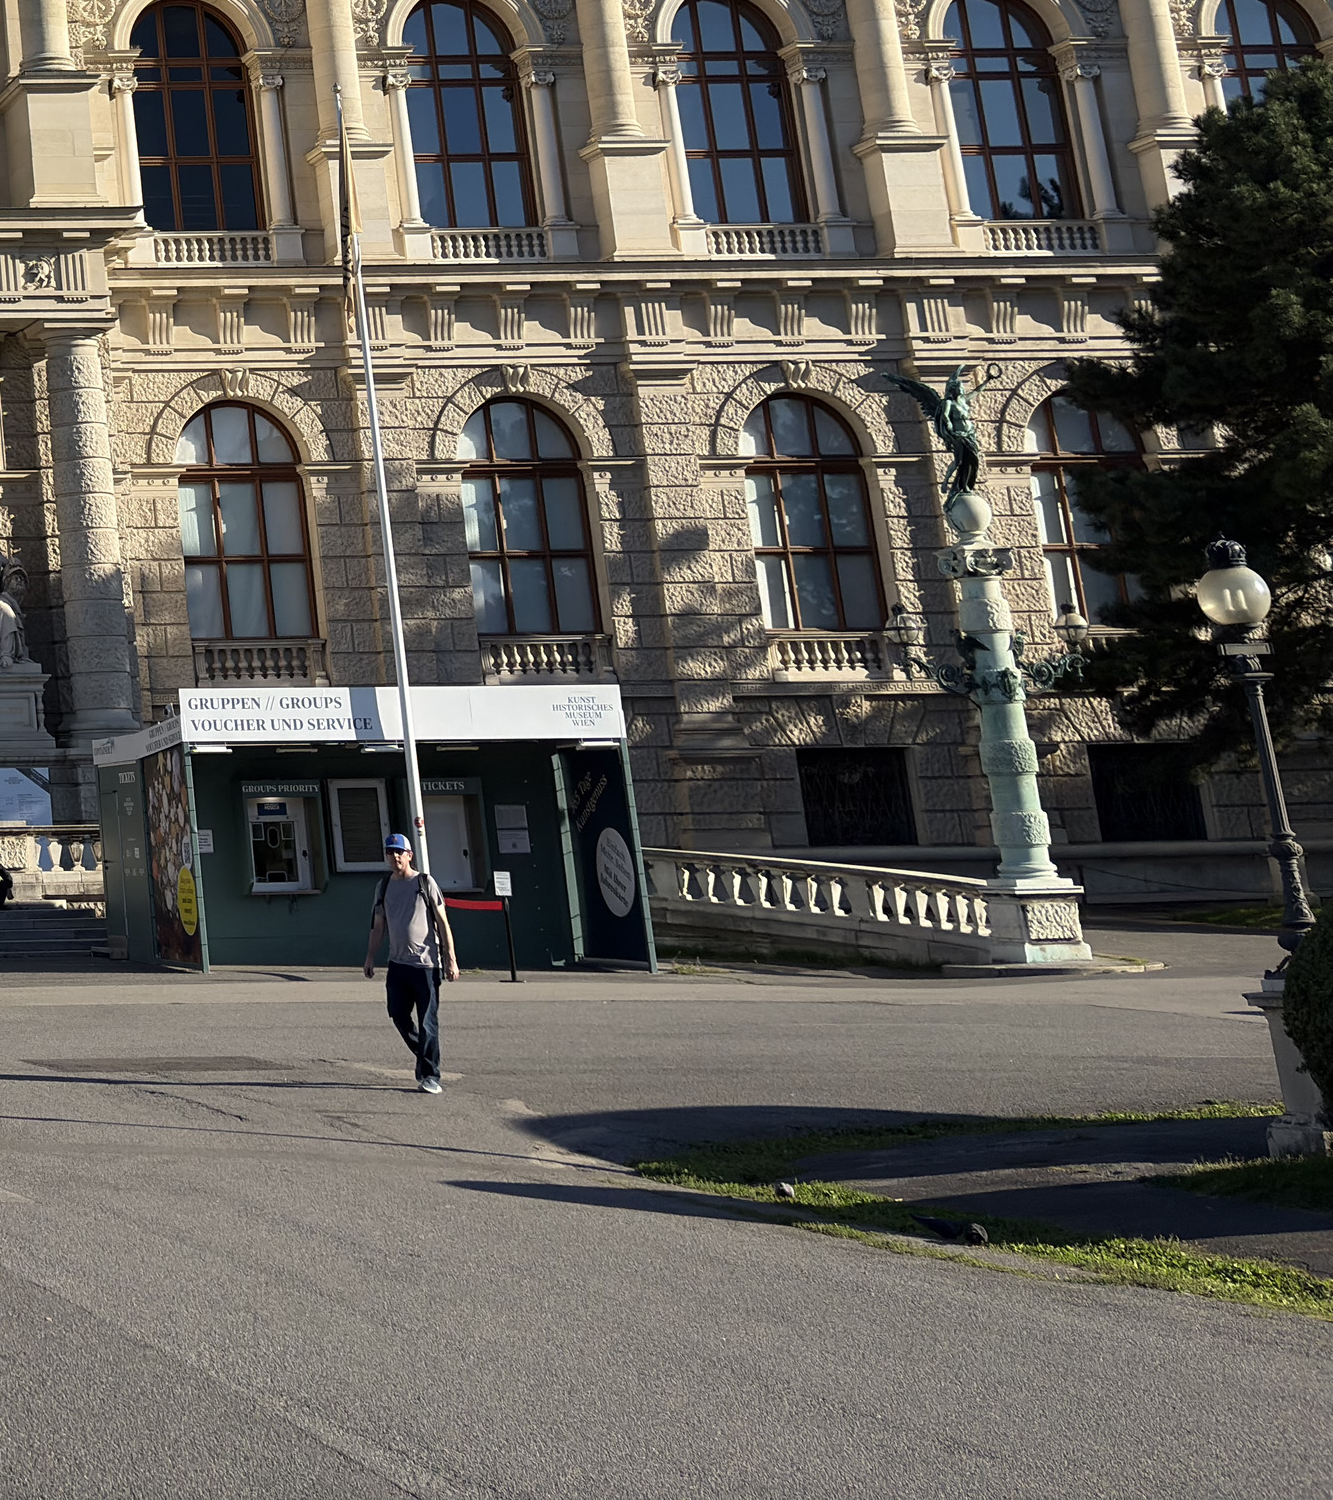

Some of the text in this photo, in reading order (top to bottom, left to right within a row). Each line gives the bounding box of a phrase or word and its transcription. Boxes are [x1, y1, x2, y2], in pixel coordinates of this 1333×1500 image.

[187, 697, 261, 710] GRUPPEN
[279, 696, 342, 709] GROUPS
[552, 703, 614, 711] HISTORISCHES
[565, 711, 602, 719] MUSEUM
[190, 718, 267, 732] VOUCHER
[270, 717, 304, 731] UND
[307, 717, 373, 731] SERVICE
[242, 784, 320, 793] GROUPS PRIORITY
[421, 781, 465, 791] TICKETS
